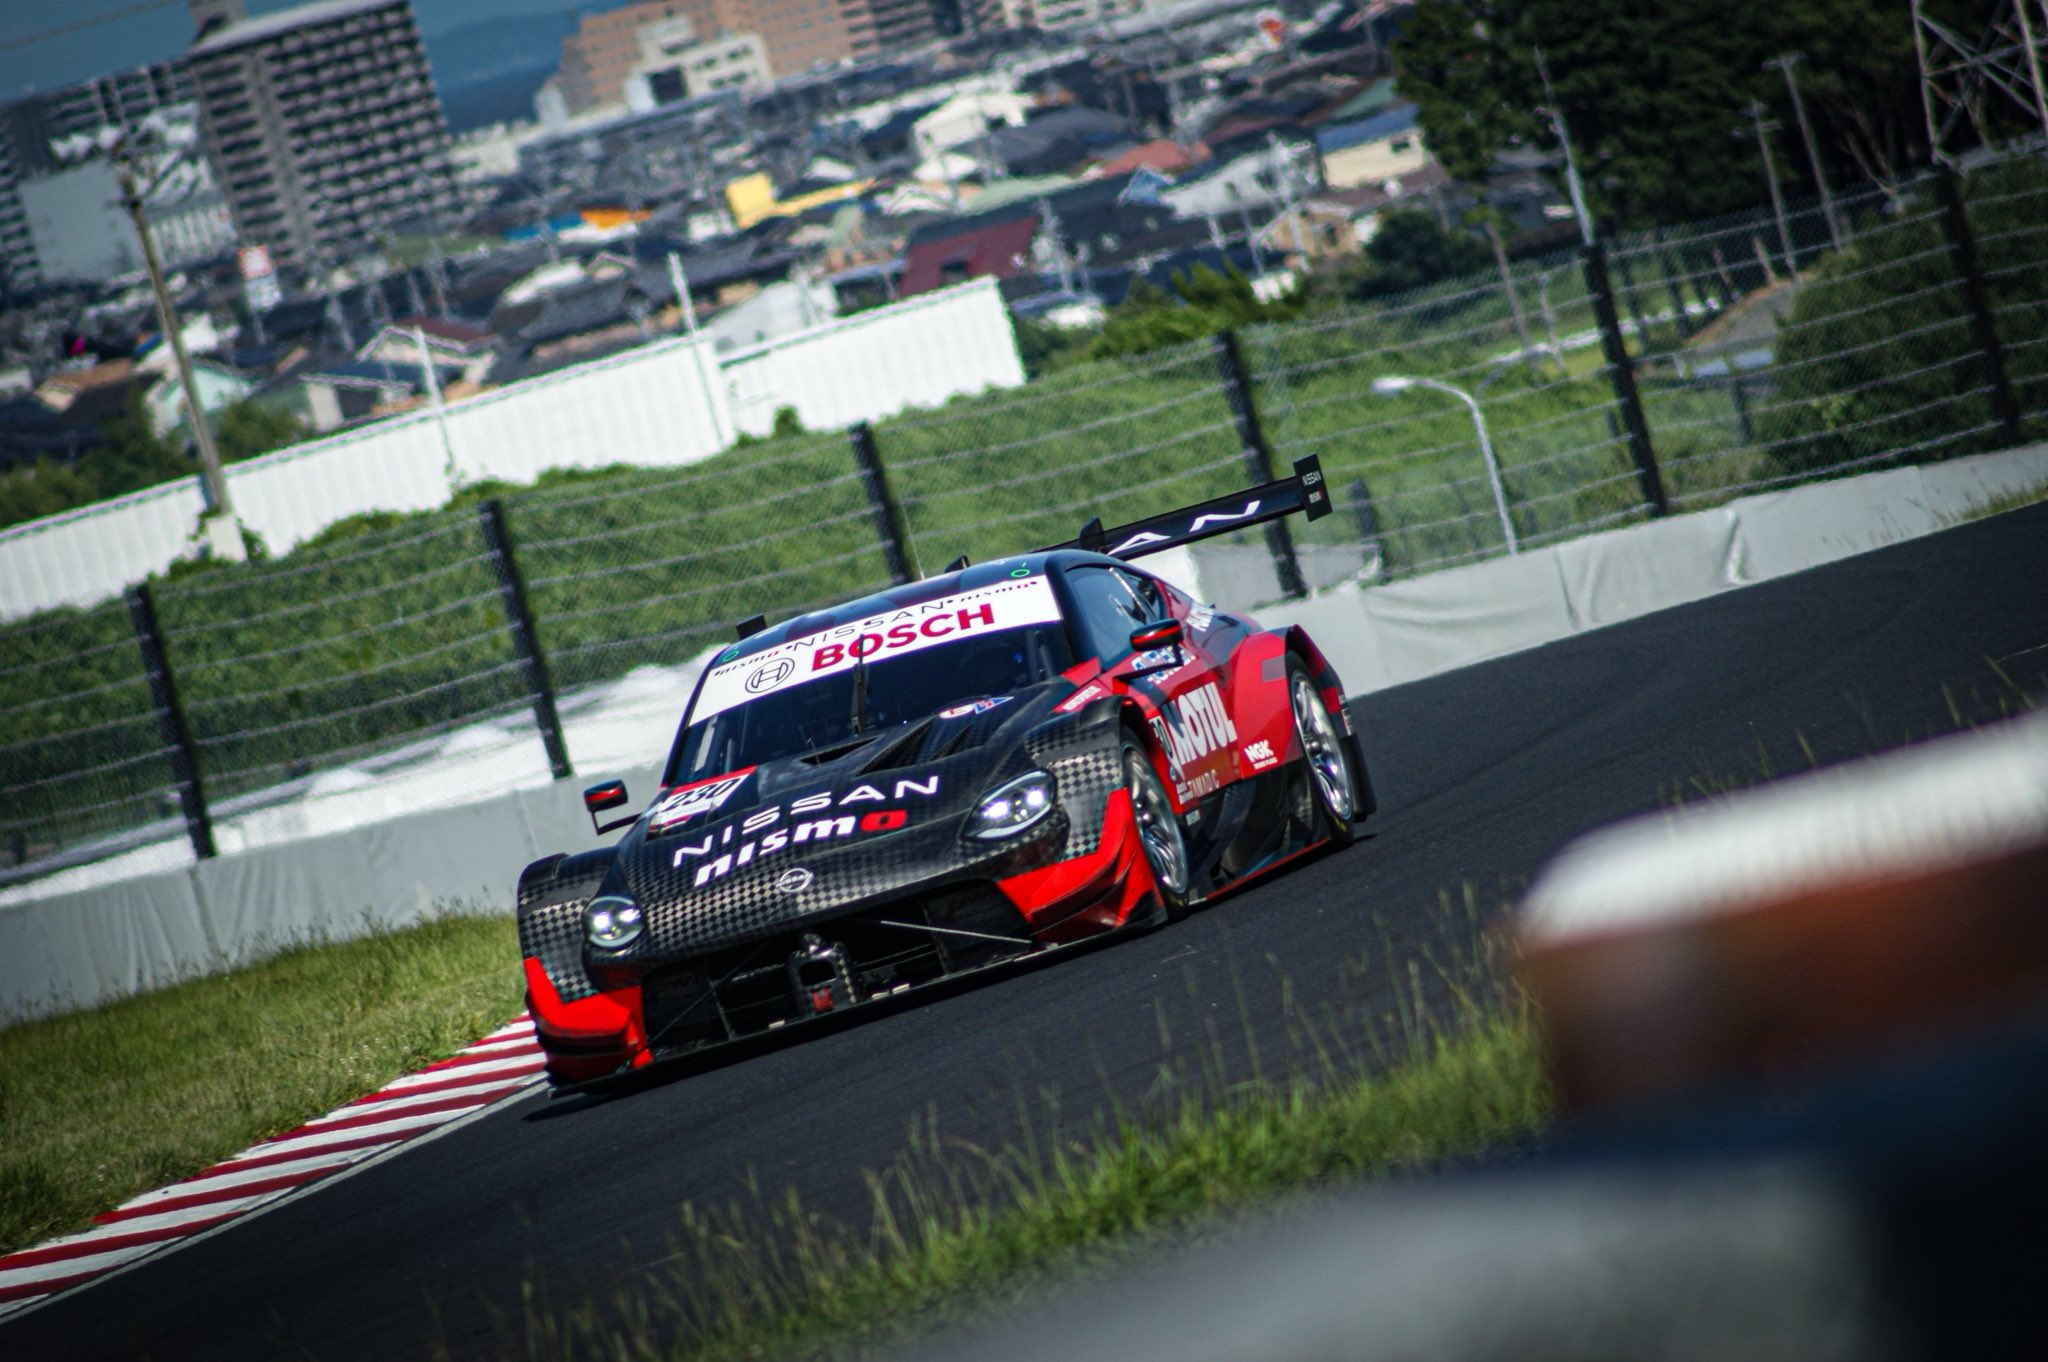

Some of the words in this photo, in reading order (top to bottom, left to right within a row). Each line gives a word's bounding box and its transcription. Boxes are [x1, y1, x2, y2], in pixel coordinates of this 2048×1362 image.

[790, 600, 943, 652] NISSAN
[811, 603, 995, 672] BOSCH
[1161, 681, 1238, 766] MOTUL
[1244, 739, 1275, 763] NGK
[673, 776, 939, 868] NISSAN
[694, 809, 908, 888] nismo
